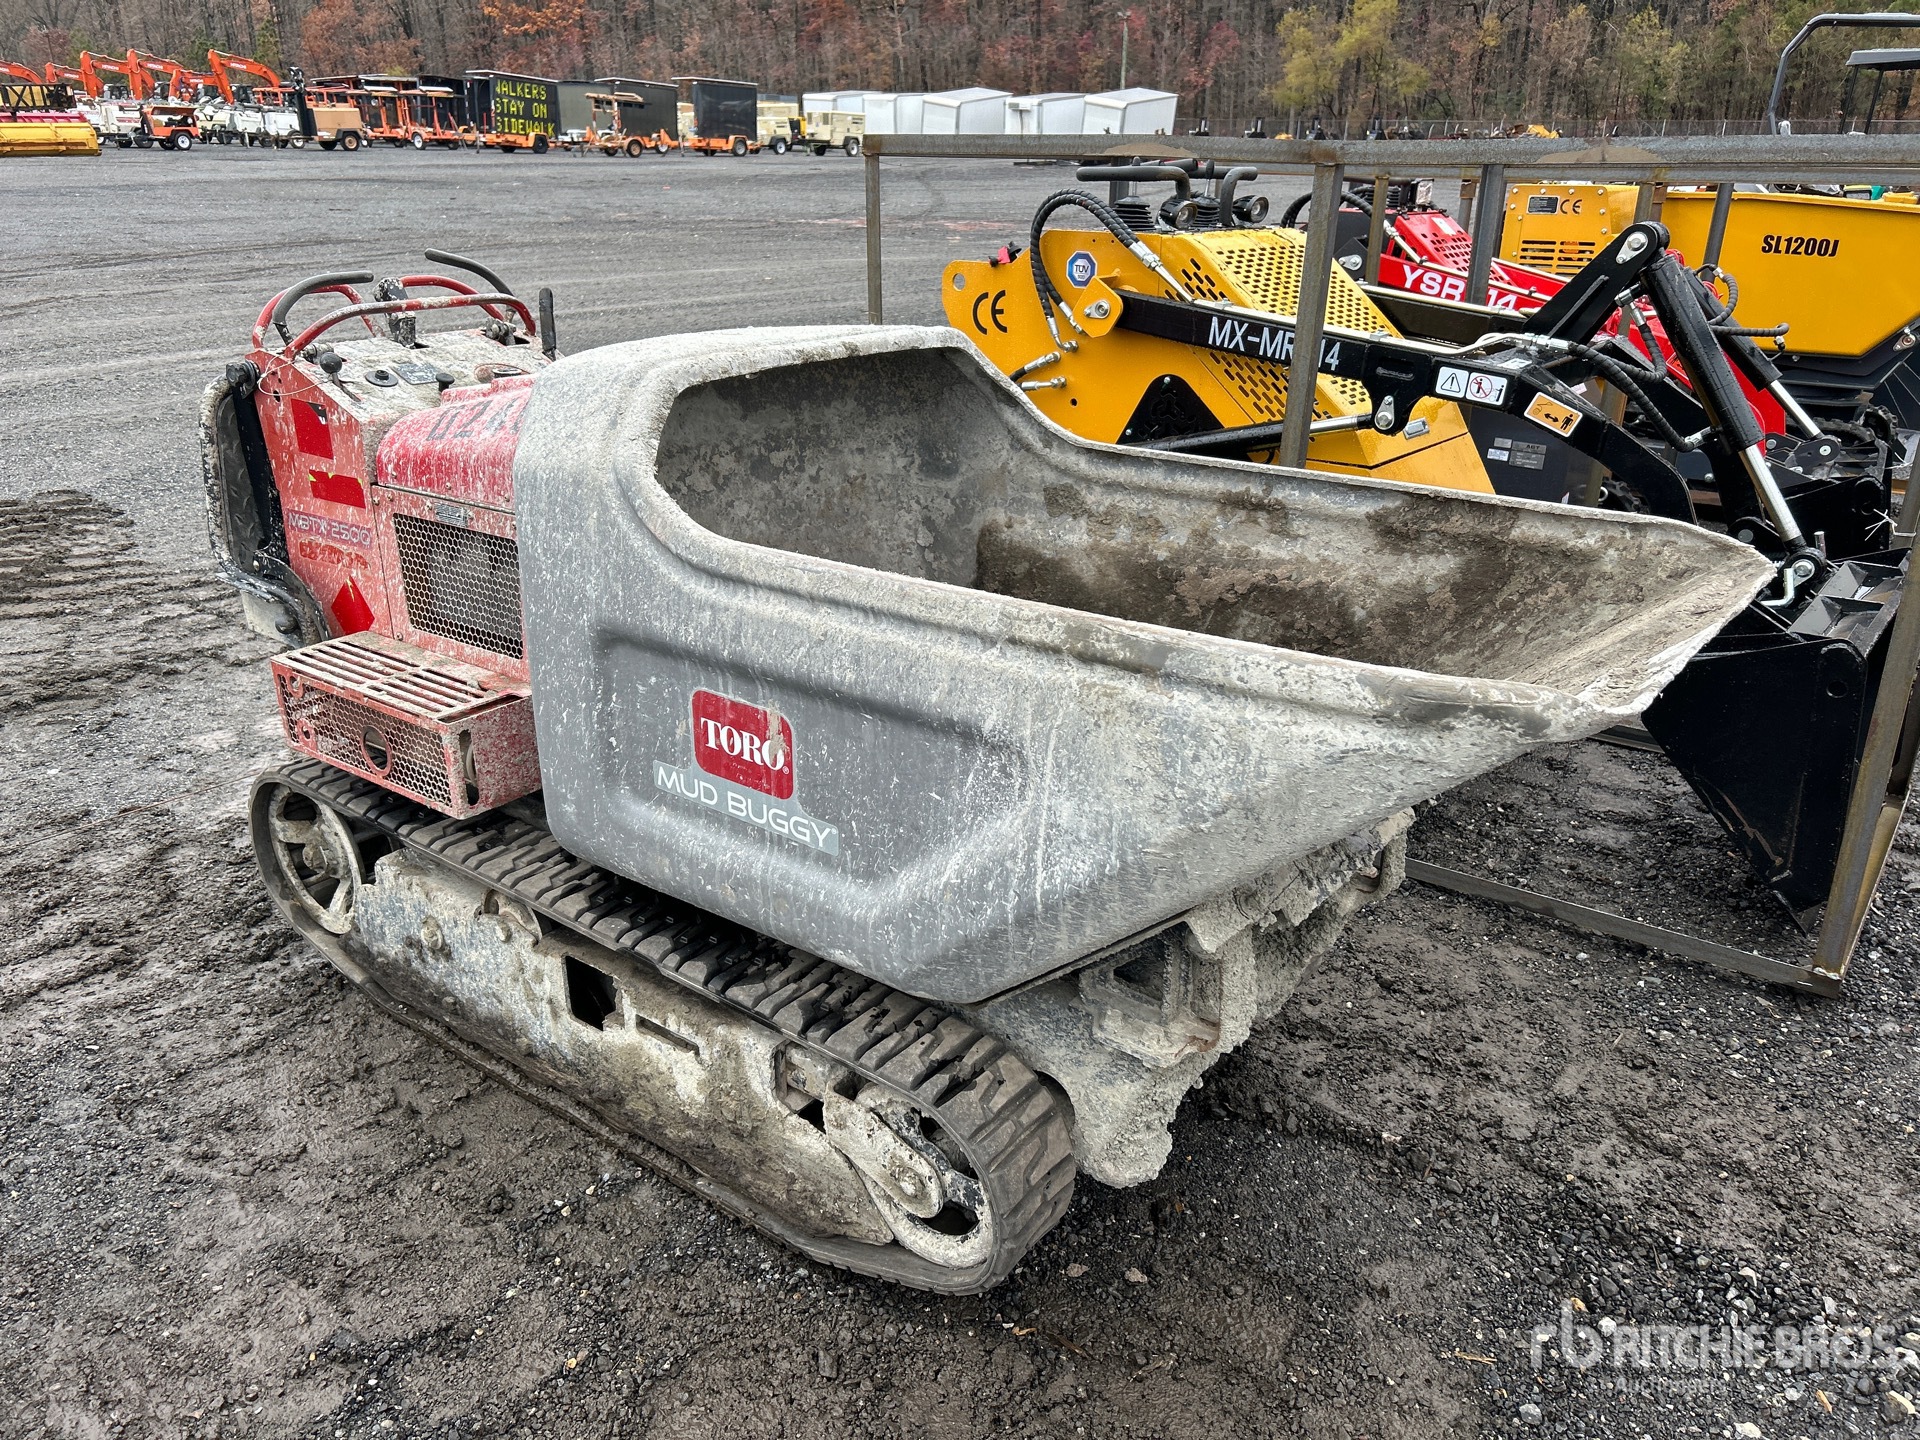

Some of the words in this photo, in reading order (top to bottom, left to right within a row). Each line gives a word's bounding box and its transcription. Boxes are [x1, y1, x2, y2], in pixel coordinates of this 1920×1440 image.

[496, 98, 524, 115] STAY
[532, 102, 548, 118] ON
[1761, 234, 1840, 256] SL1200J
[288, 512, 327, 534] MBTX
[331, 522, 371, 546] 2500
[700, 716, 786, 771] TORO
[657, 766, 718, 805] MUD
[727, 791, 831, 847] BUGGY
